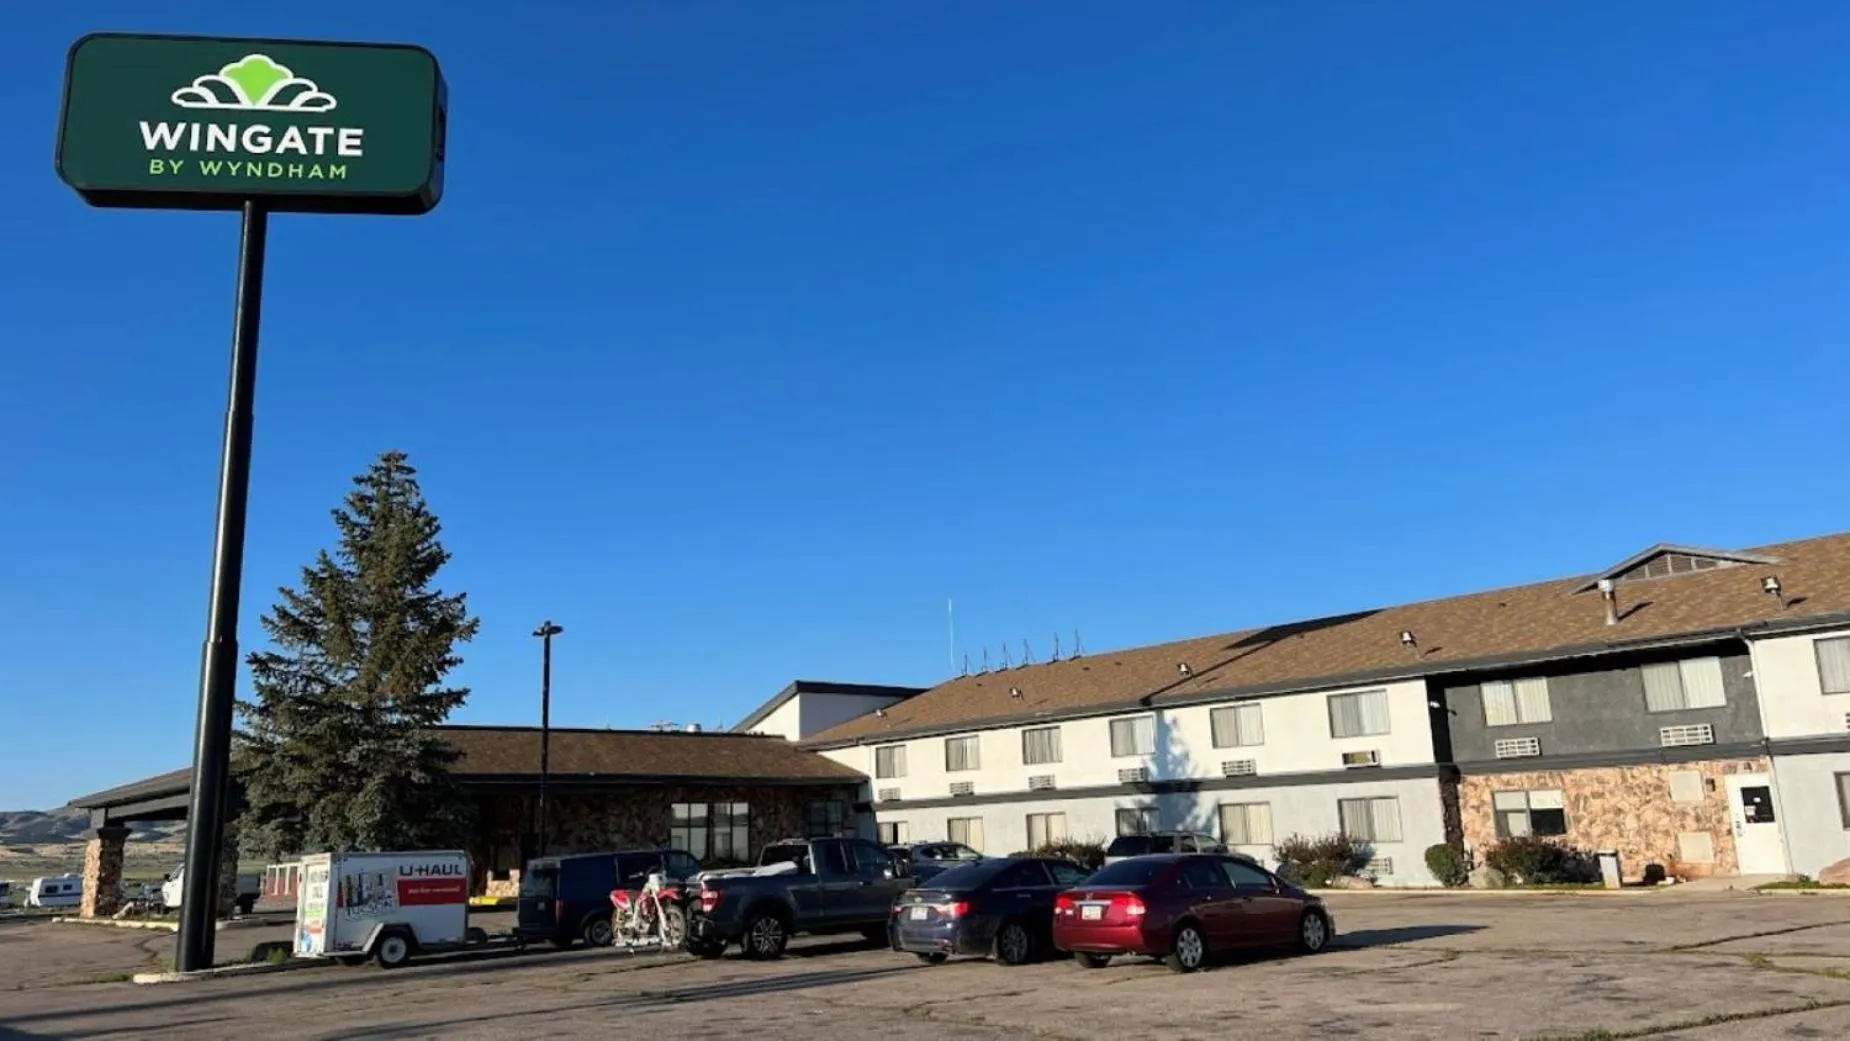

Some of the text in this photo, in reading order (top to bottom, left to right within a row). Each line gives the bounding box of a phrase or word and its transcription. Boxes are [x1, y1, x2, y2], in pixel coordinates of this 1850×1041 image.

[139, 121, 364, 156] WINGATE
[149, 159, 347, 179] BY WYNDHAM
[399, 863, 463, 876] U-HAUL
